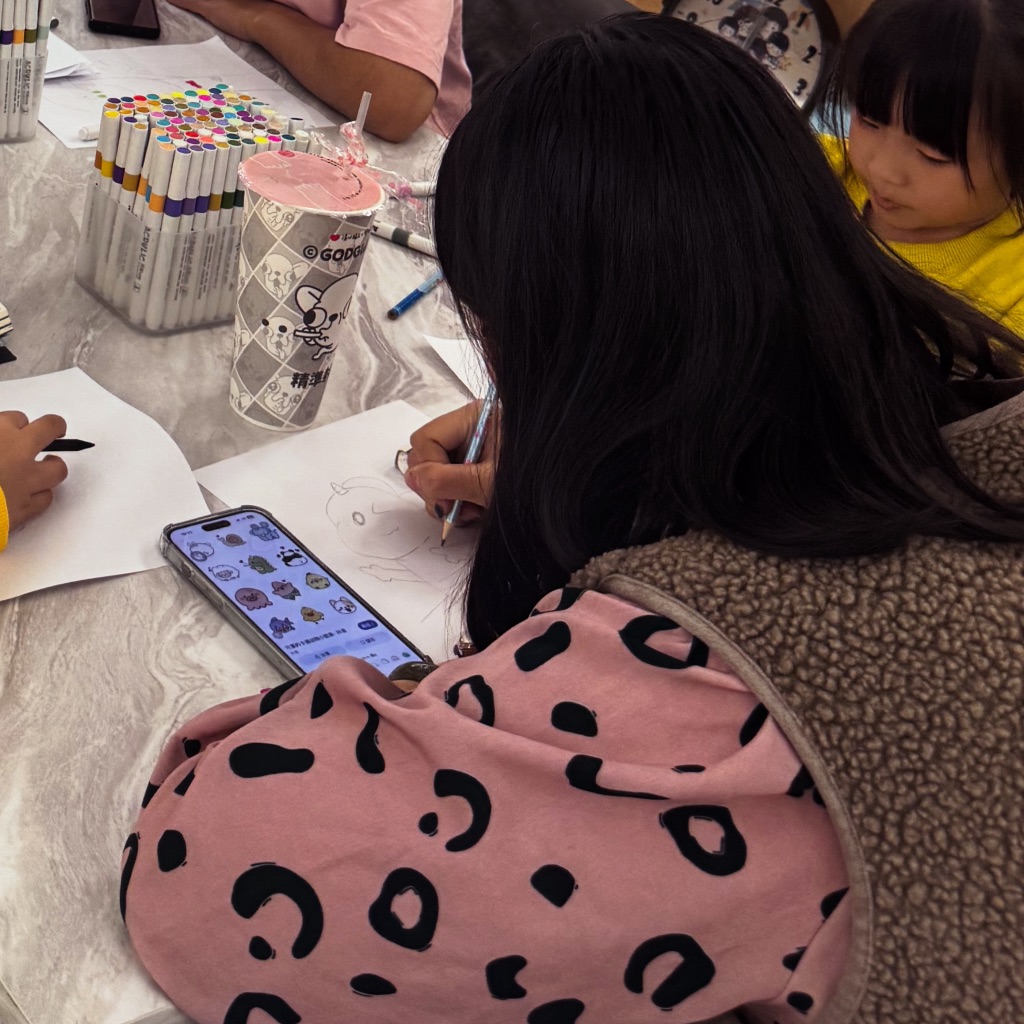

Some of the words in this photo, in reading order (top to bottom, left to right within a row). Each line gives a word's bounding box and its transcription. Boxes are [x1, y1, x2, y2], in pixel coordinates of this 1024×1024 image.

[796, 12, 808, 29] 1
[801, 45, 818, 64] 2
[793, 78, 808, 96] 3
